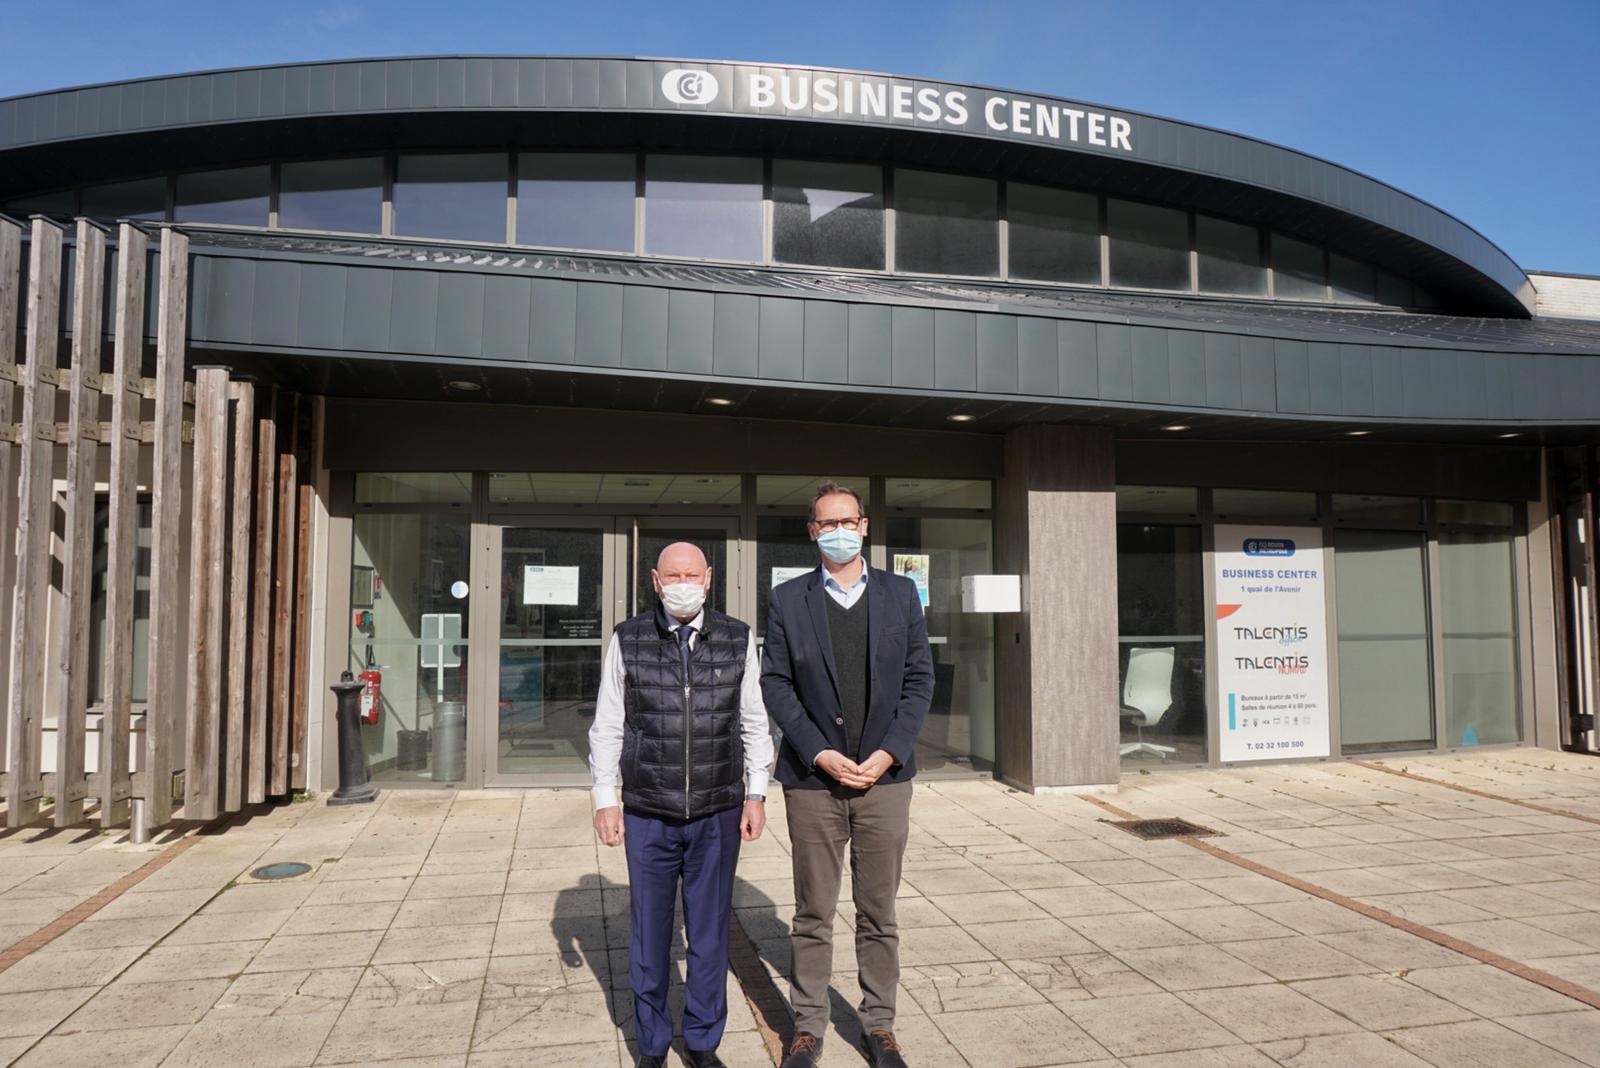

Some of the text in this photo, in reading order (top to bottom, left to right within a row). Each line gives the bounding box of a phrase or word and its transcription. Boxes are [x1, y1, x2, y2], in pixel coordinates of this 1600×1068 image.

[748, 73, 1133, 151] BUSINESS CENTER
[1222, 569, 1317, 579] BUSINESS CENTER
[1247, 585, 1262, 594] quai
